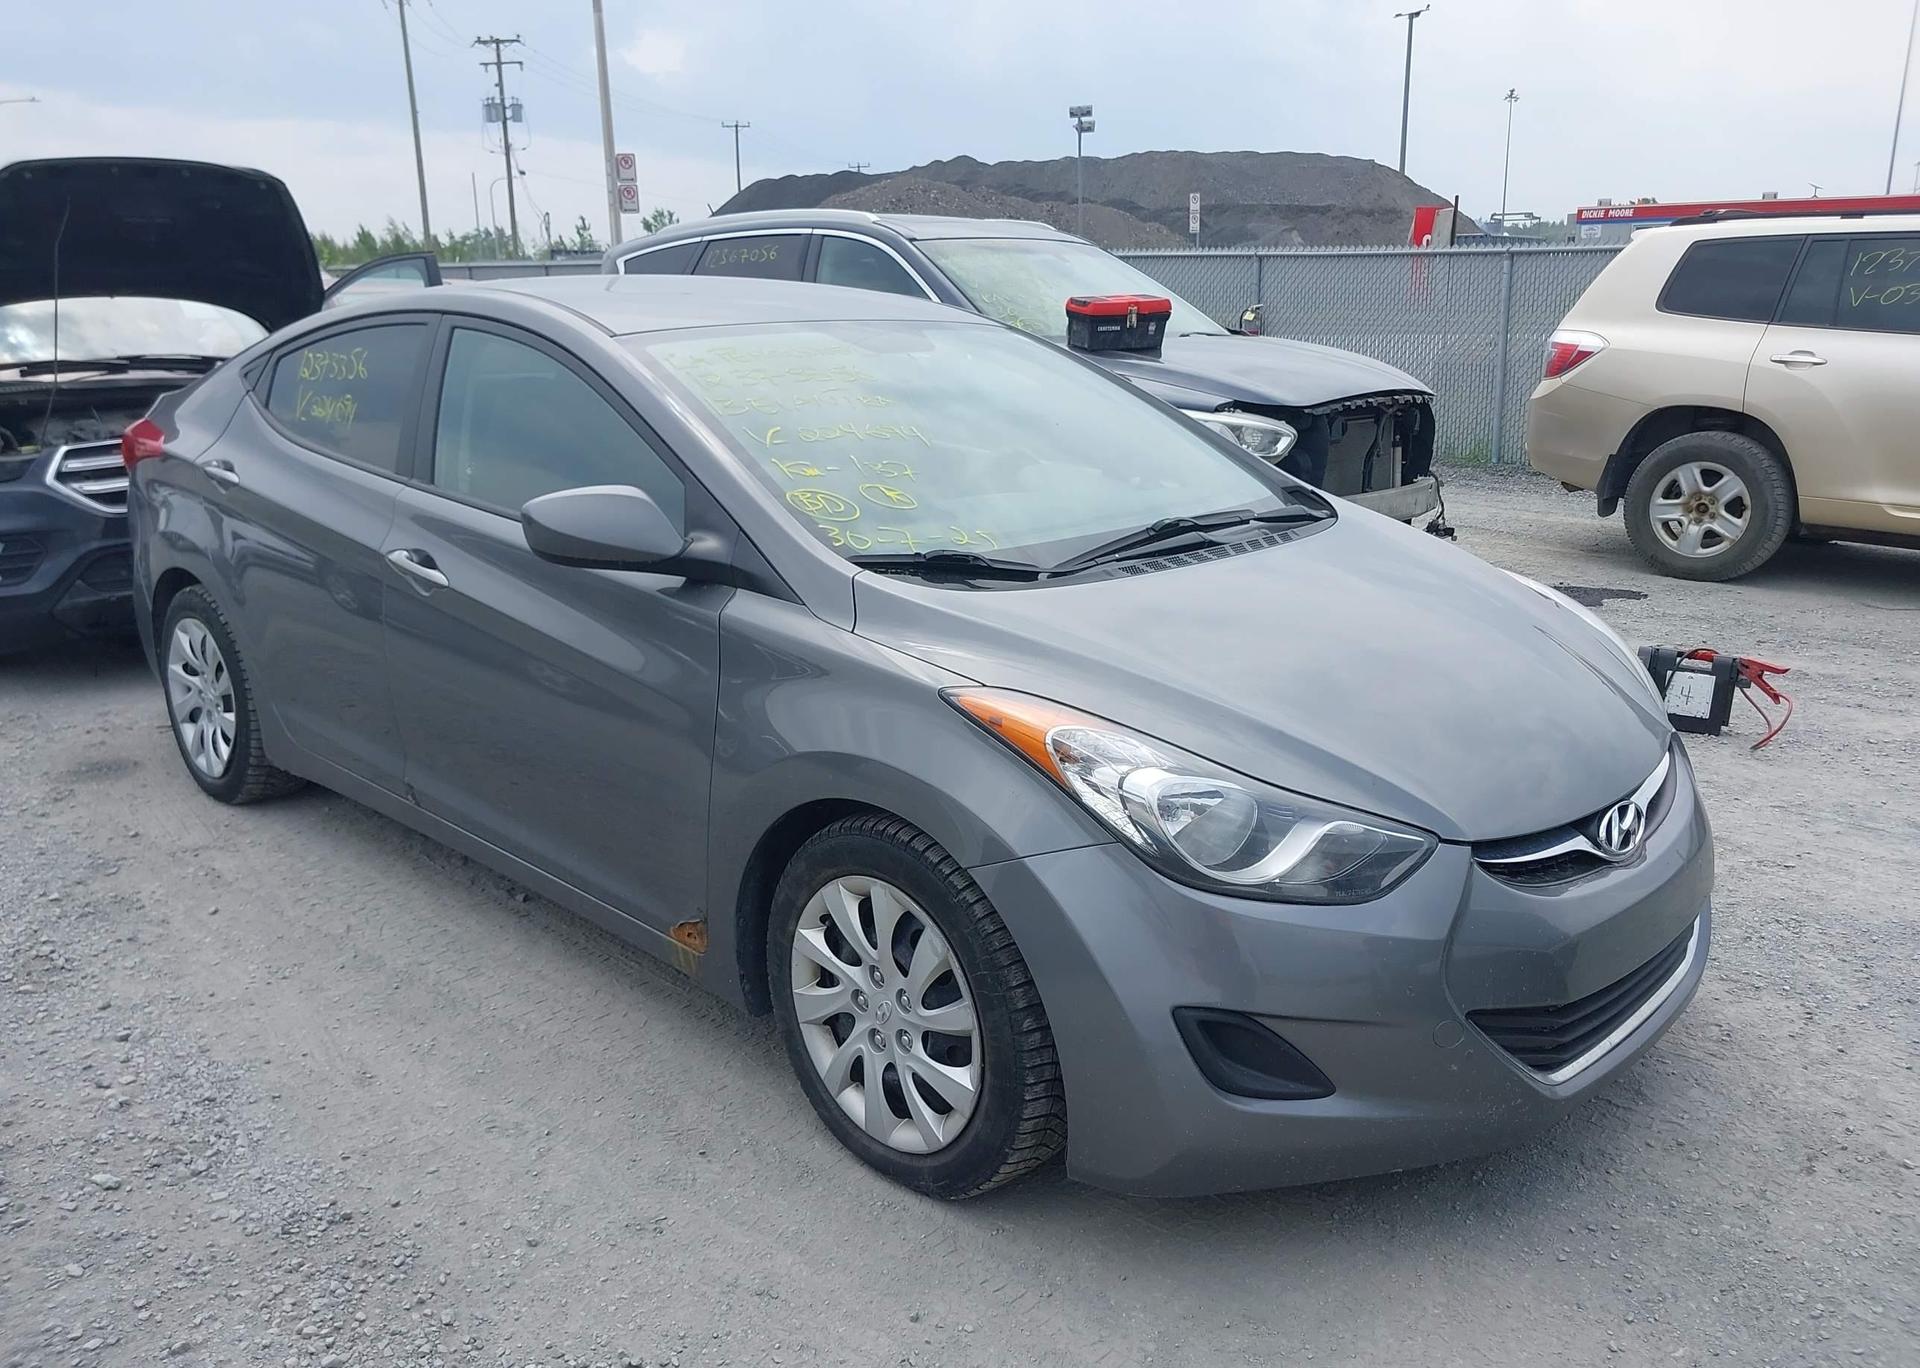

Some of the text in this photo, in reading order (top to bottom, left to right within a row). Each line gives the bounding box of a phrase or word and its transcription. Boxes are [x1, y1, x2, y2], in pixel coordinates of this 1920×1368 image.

[1581, 208, 1635, 219] DICKIE MOORE
[1680, 684, 1695, 706] 4
